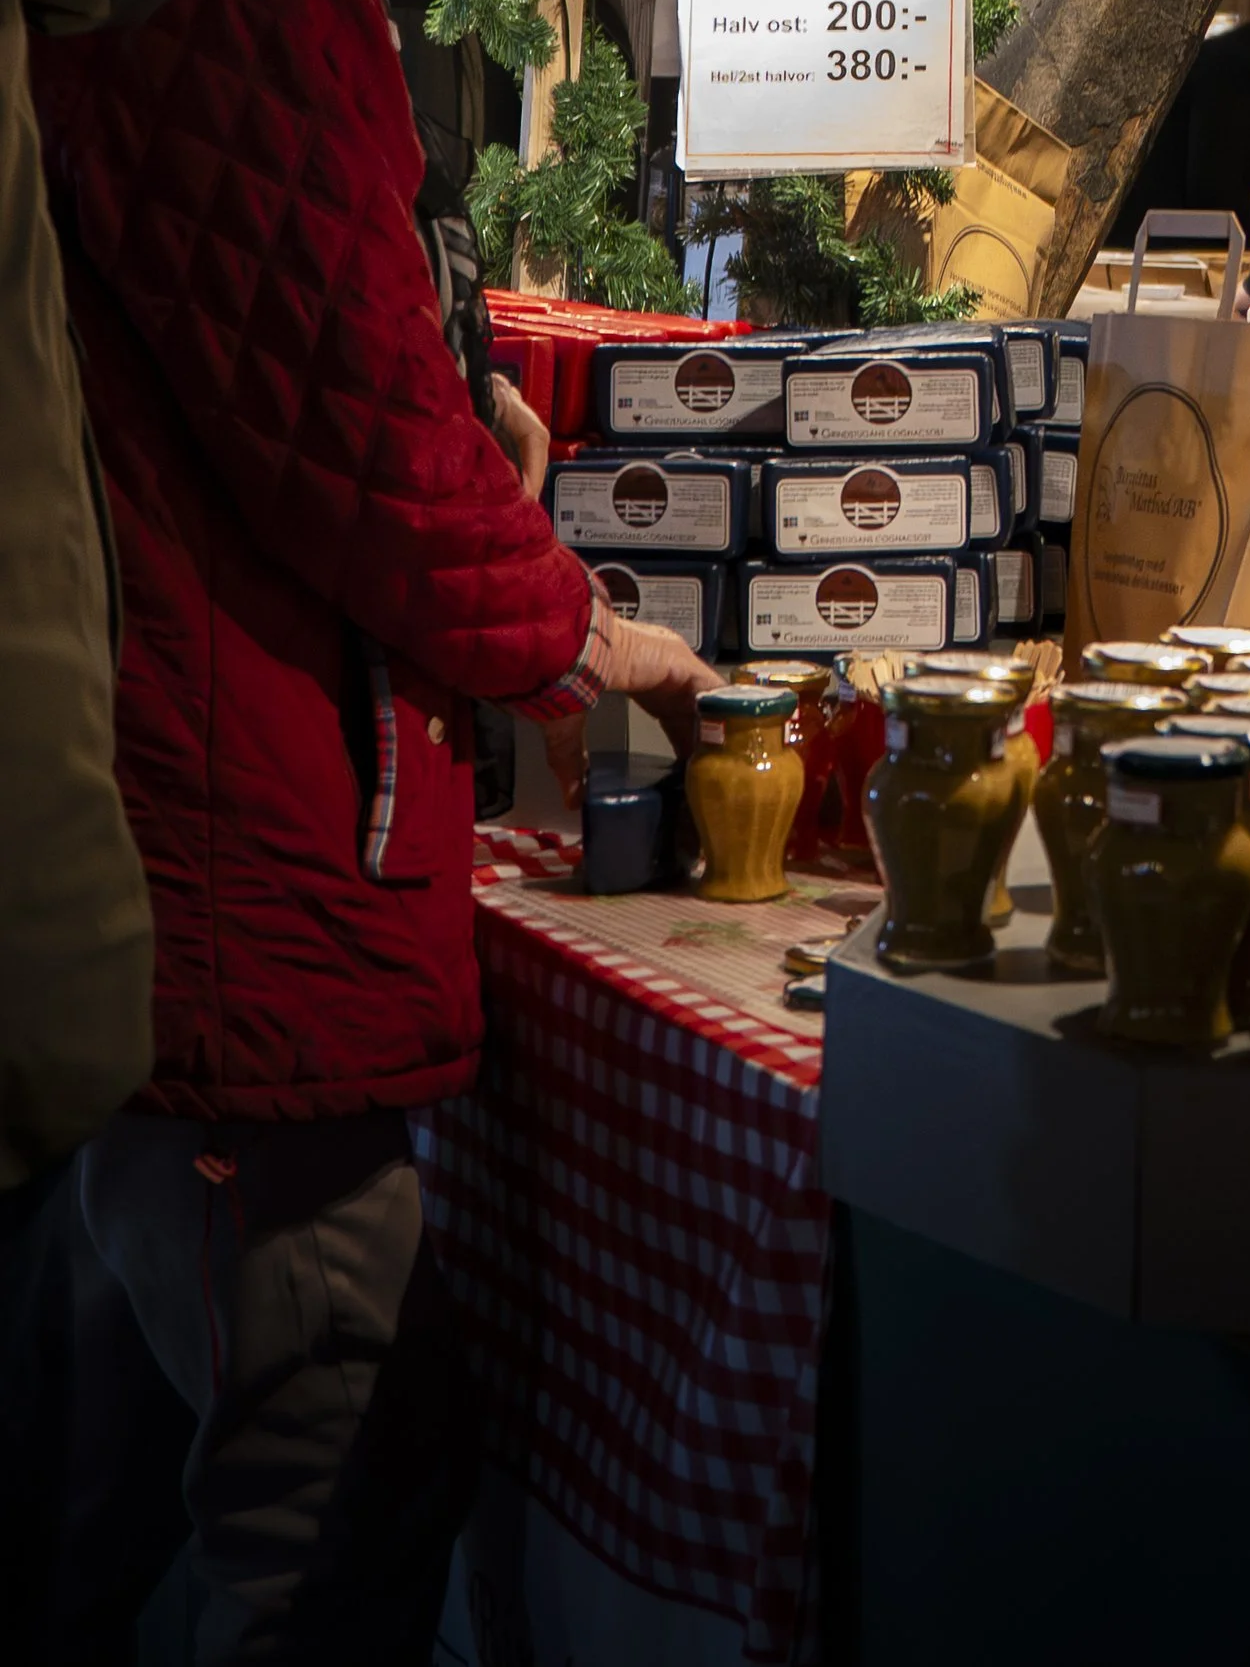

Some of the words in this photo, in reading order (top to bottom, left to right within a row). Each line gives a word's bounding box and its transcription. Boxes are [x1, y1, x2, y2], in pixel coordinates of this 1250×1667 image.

[713, 16, 760, 33] Halv
[767, 17, 808, 33] ost:
[826, 0, 927, 31] 200:-
[710, 70, 760, 83] Hel/2st
[826, 48, 927, 81] 380:-
